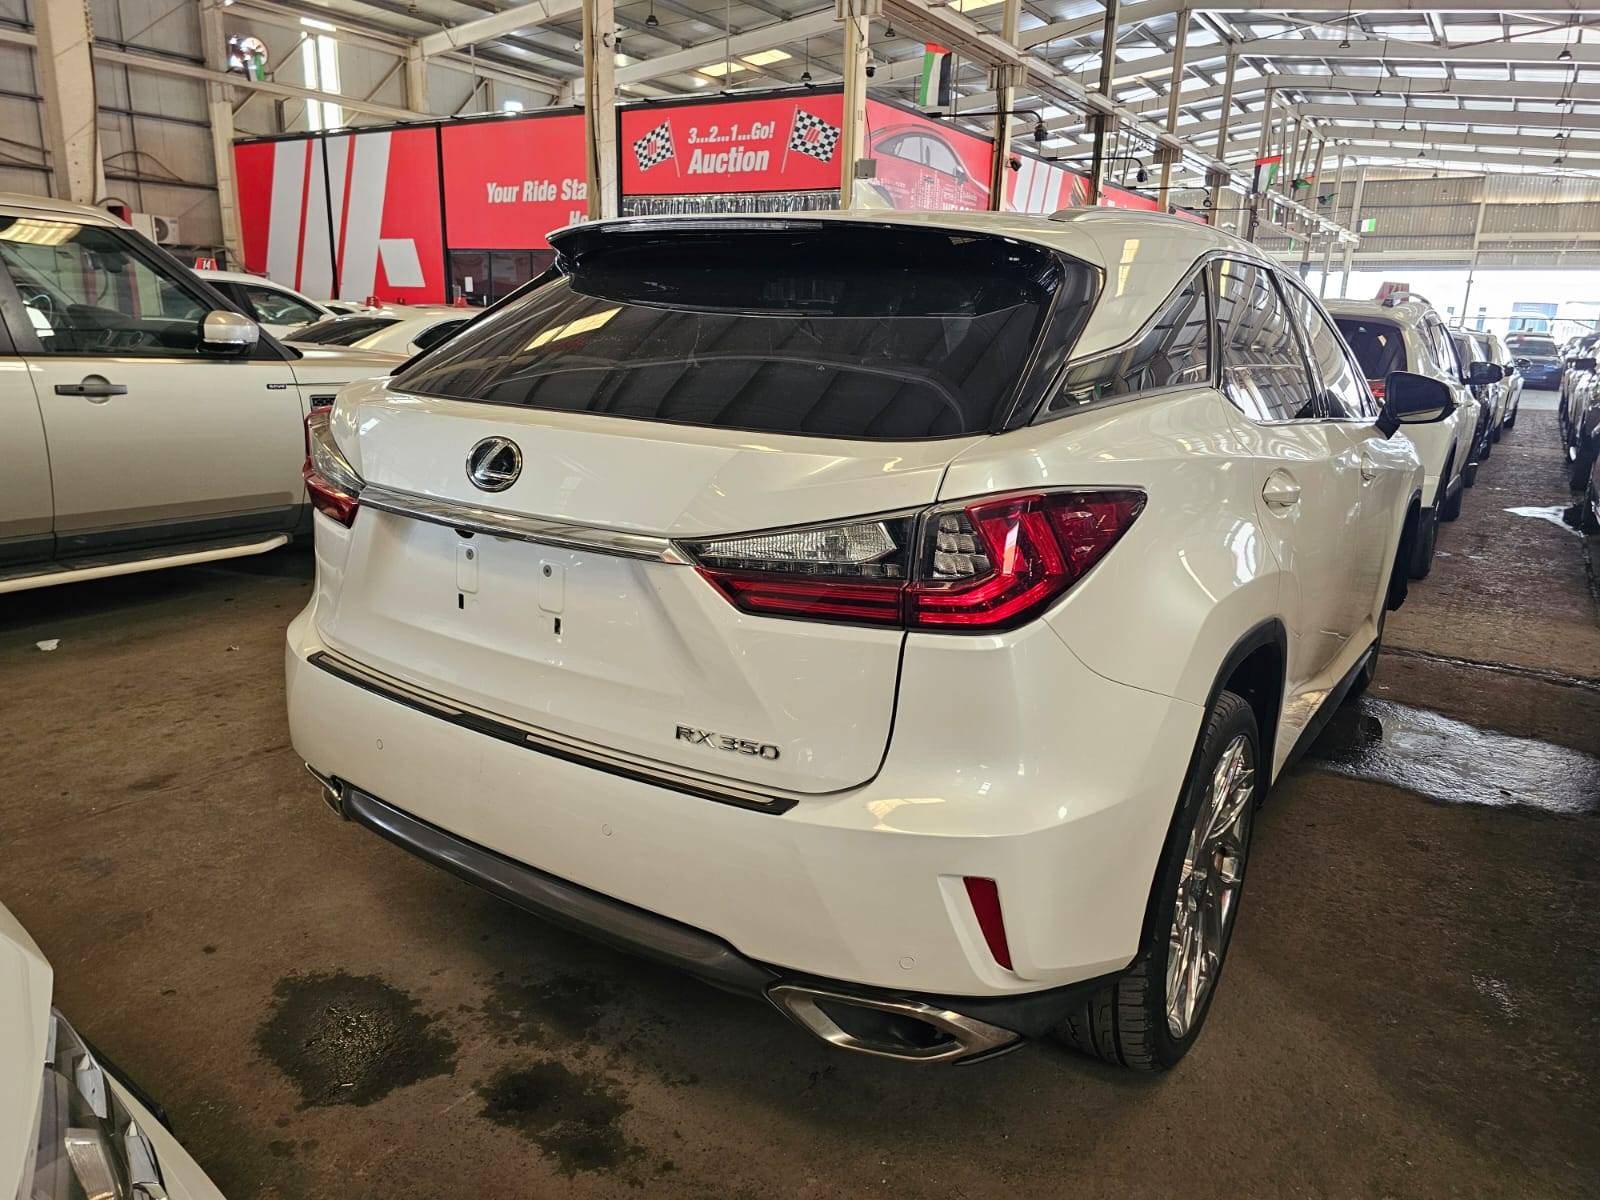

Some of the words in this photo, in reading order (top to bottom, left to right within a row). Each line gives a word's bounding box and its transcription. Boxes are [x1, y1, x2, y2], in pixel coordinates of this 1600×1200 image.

[687, 146, 770, 174] Auction
[486, 182, 519, 204] Your
[522, 180, 557, 202] Ride
